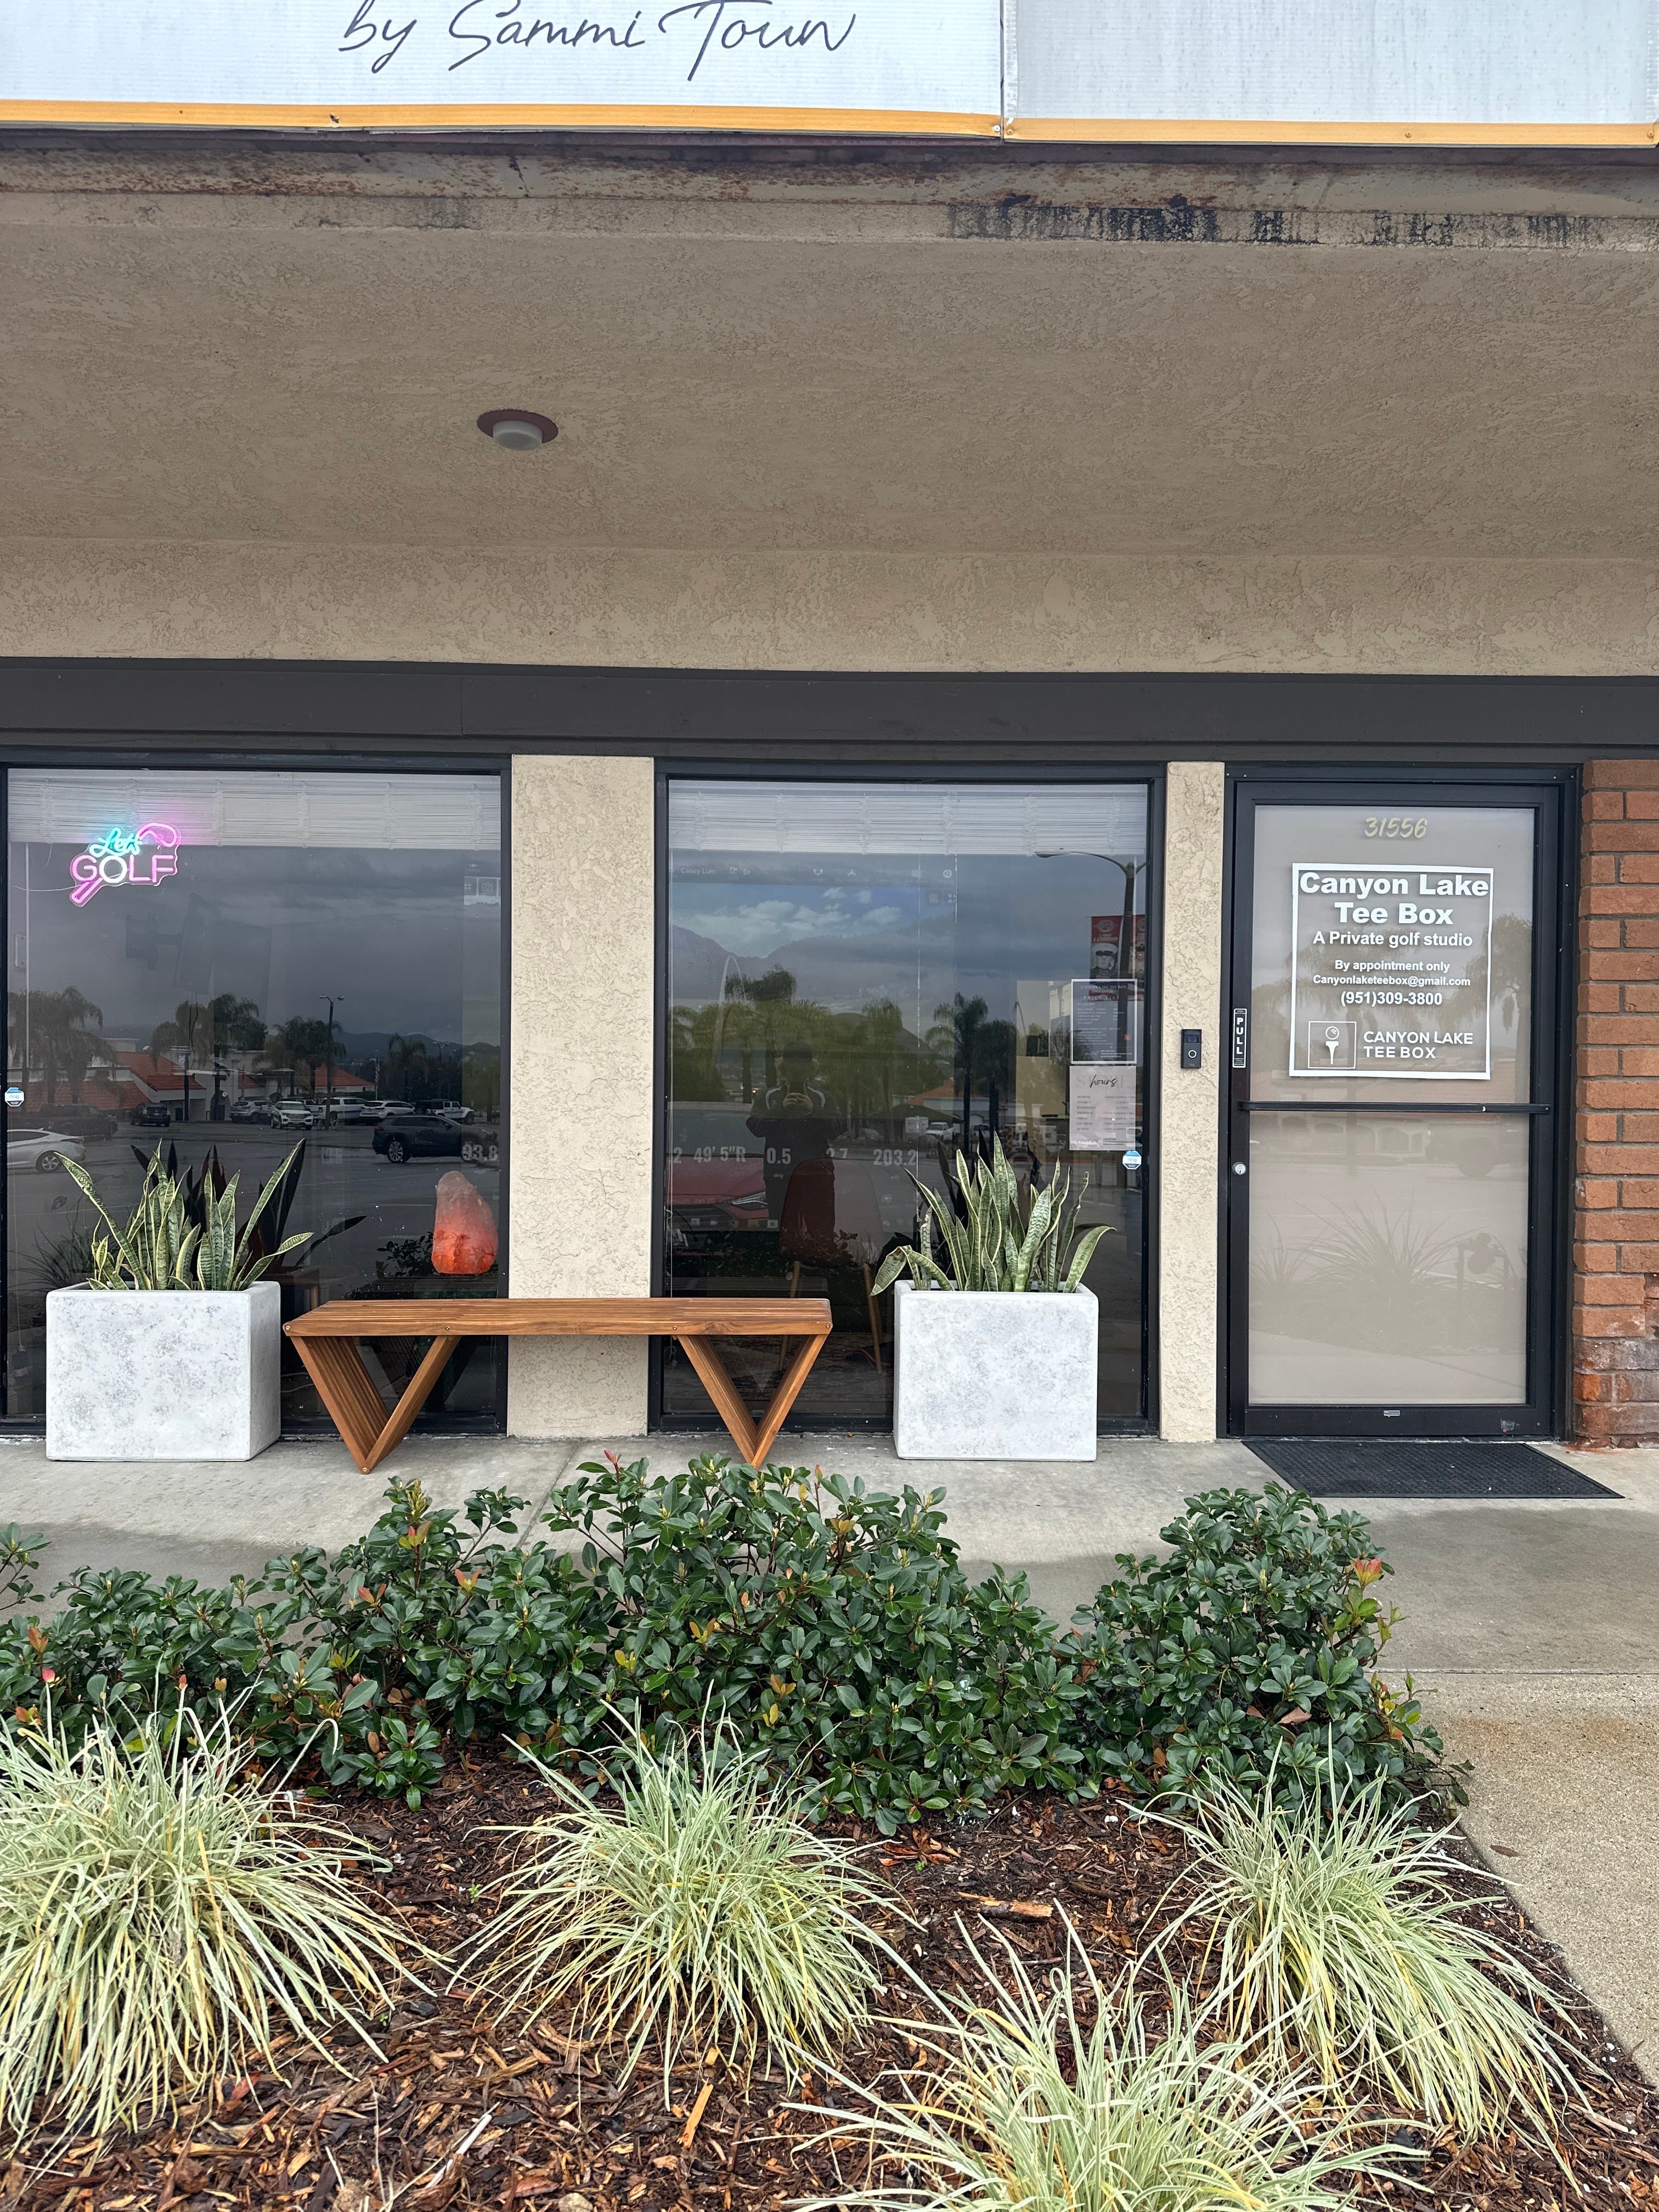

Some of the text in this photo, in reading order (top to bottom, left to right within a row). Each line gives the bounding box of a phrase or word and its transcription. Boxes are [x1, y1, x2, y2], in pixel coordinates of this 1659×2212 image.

[338, 0, 419, 72] by
[448, 0, 646, 70] Sammi
[1364, 817, 1428, 838] 31556
[72, 855, 174, 883] GOLF
[1300, 872, 1489, 899] Canyon Lake
[1334, 901, 1454, 925] Tee Box
[1313, 931, 1473, 949] A Private golf studio
[1335, 960, 1451, 973] By appointment only
[1313, 974, 1471, 988] Canyonlaketeebox@gmail.com
[1341, 991, 1442, 1007] (951)309-3800
[1363, 1031, 1474, 1045] CANYON LAKE
[1363, 1046, 1436, 1059] TEE BOX
[1090, 1074, 1118, 1088] hours
[766, 1147, 791, 1164] 0.5
[873, 1149, 916, 1166] 203.2
